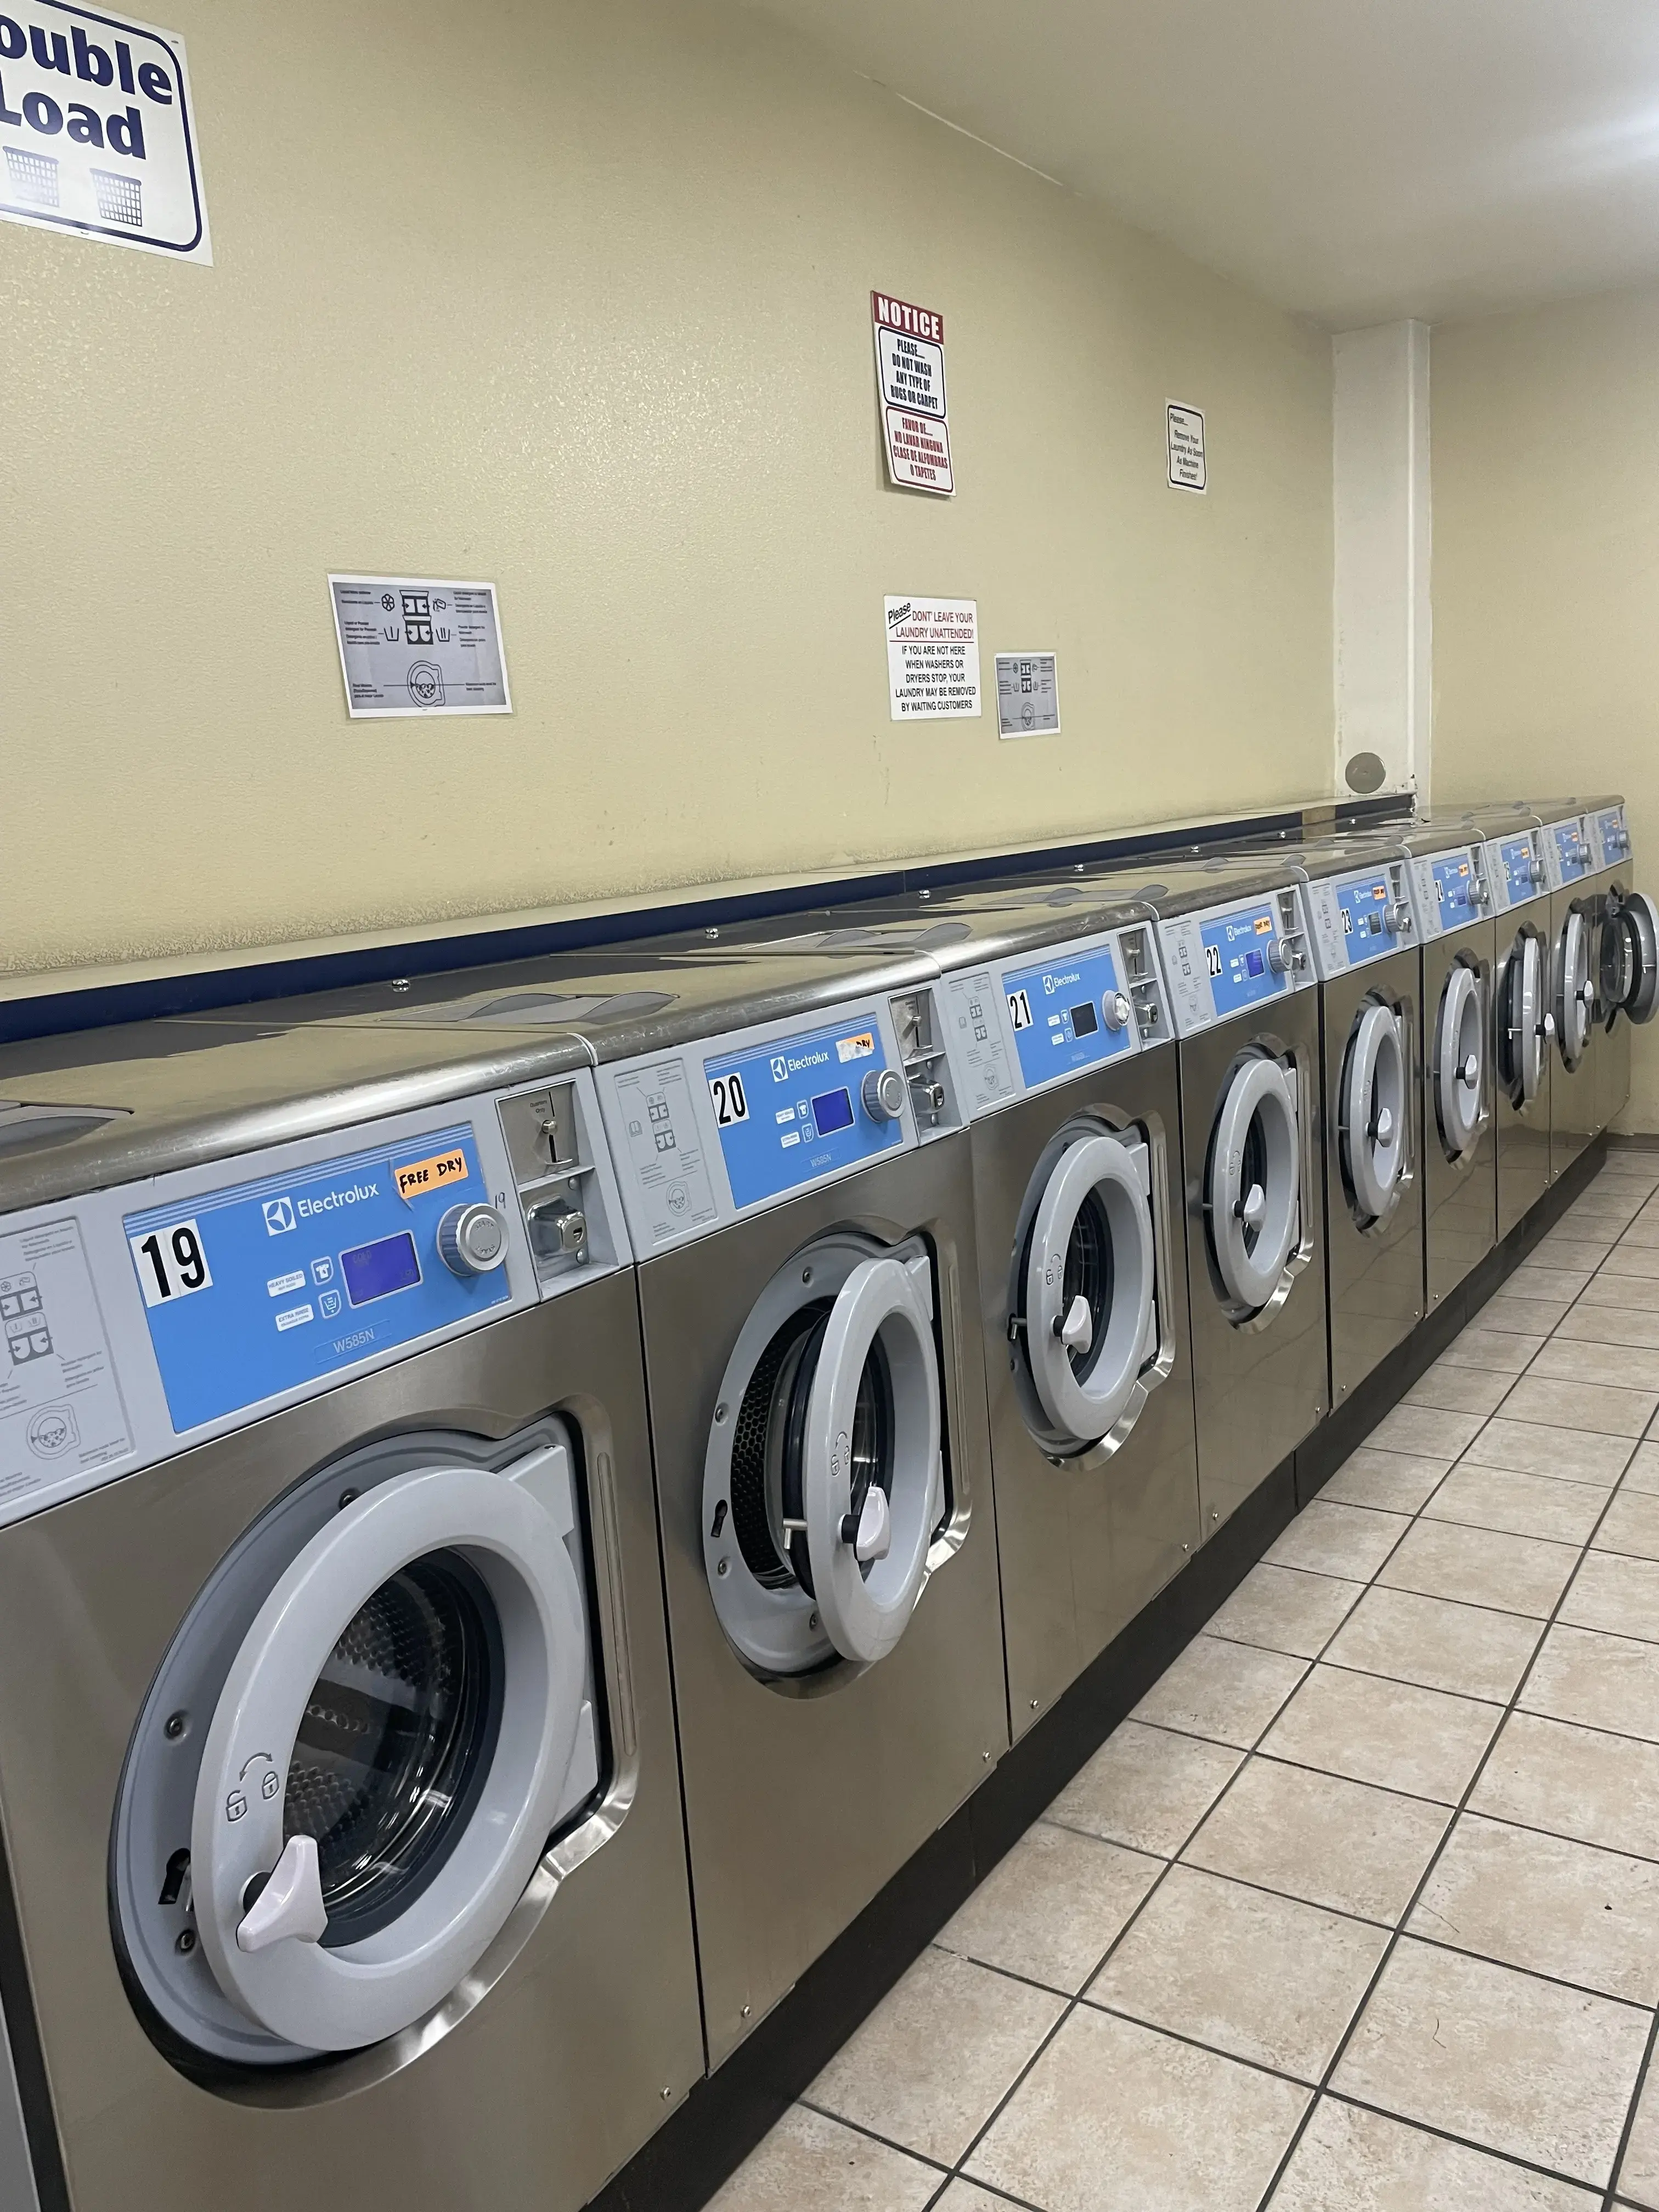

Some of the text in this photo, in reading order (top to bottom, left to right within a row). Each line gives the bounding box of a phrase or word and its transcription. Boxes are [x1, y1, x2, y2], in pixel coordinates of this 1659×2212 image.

[878, 296, 940, 340] NOTICE
[892, 353, 932, 377] DO NOT WASH
[896, 370, 930, 392] ANY TYPE OF
[890, 385, 938, 409] RUGS OR CARPET
[902, 417, 919, 432] FAVOR
[894, 430, 944, 454] NO LAVAR NINGUNA
[1187, 447, 1193, 455] As
[893, 445, 948, 469] CLASE DE ALFOMBRAS
[1177, 455, 1182, 465] As
[910, 464, 936, 481] O TAPETES
[888, 602, 911, 624] Please
[934, 612, 954, 622] LEAVE
[955, 612, 973, 623] YOUR
[896, 627, 974, 639] LAUNDRY UNATTENDED!
[902, 646, 966, 654] IF YOU ARE NOT HERE
[905, 659, 963, 669] WHEN WASHERS OR
[906, 673, 965, 684] DRYERS STOP, YOUR
[895, 686, 976, 697] LAUNDRY MAY BE REMOVED
[901, 700, 972, 712] BY WAITING CUSTOMERS
[1341, 910, 1352, 933] 23
[1207, 947, 1221, 976] 22
[1053, 973, 1081, 986] Electrolux
[1010, 992, 1030, 1029] 21
[788, 1052, 829, 1071] Electrolux
[713, 1075, 746, 1124] 20
[399, 1157, 461, 1193] FREE DRY
[297, 1183, 379, 1217] Electrolux
[495, 1192, 506, 1209] 19
[141, 1227, 205, 1298] 19
[269, 1279, 285, 1288] HEAVY
[279, 1313, 294, 1322] EXTRA
[333, 1328, 375, 1353] W585N
